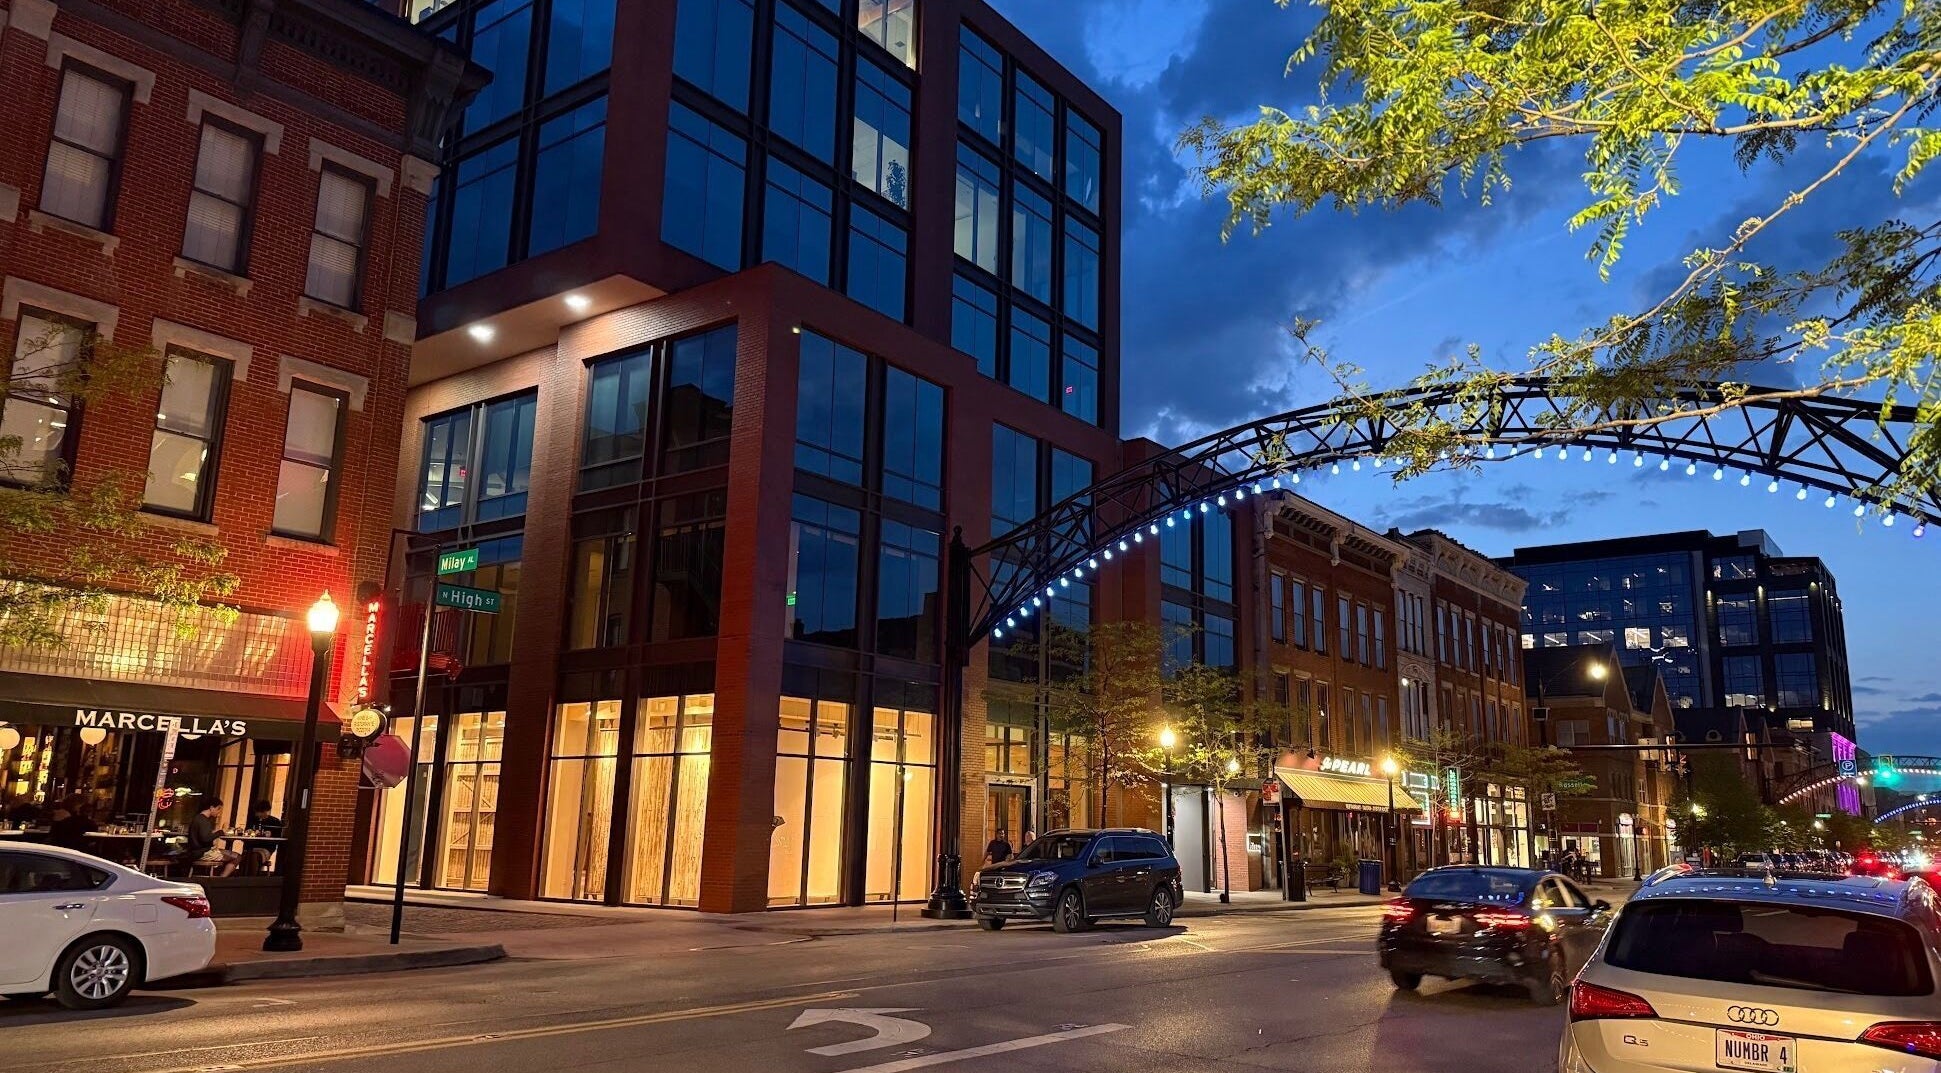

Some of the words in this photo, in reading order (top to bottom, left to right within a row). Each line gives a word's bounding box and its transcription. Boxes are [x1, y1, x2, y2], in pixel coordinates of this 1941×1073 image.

[441, 557, 466, 571] Milay
[442, 591, 449, 599] N
[451, 590, 482, 608] High
[485, 597, 495, 606] ST
[1332, 758, 1371, 776] PEARL
[1624, 1035, 1649, 1047] Q5
[1746, 1033, 1766, 1041] OHIO
[1725, 1039, 1769, 1062] NUMBR
[1779, 1046, 1788, 1065] 4
